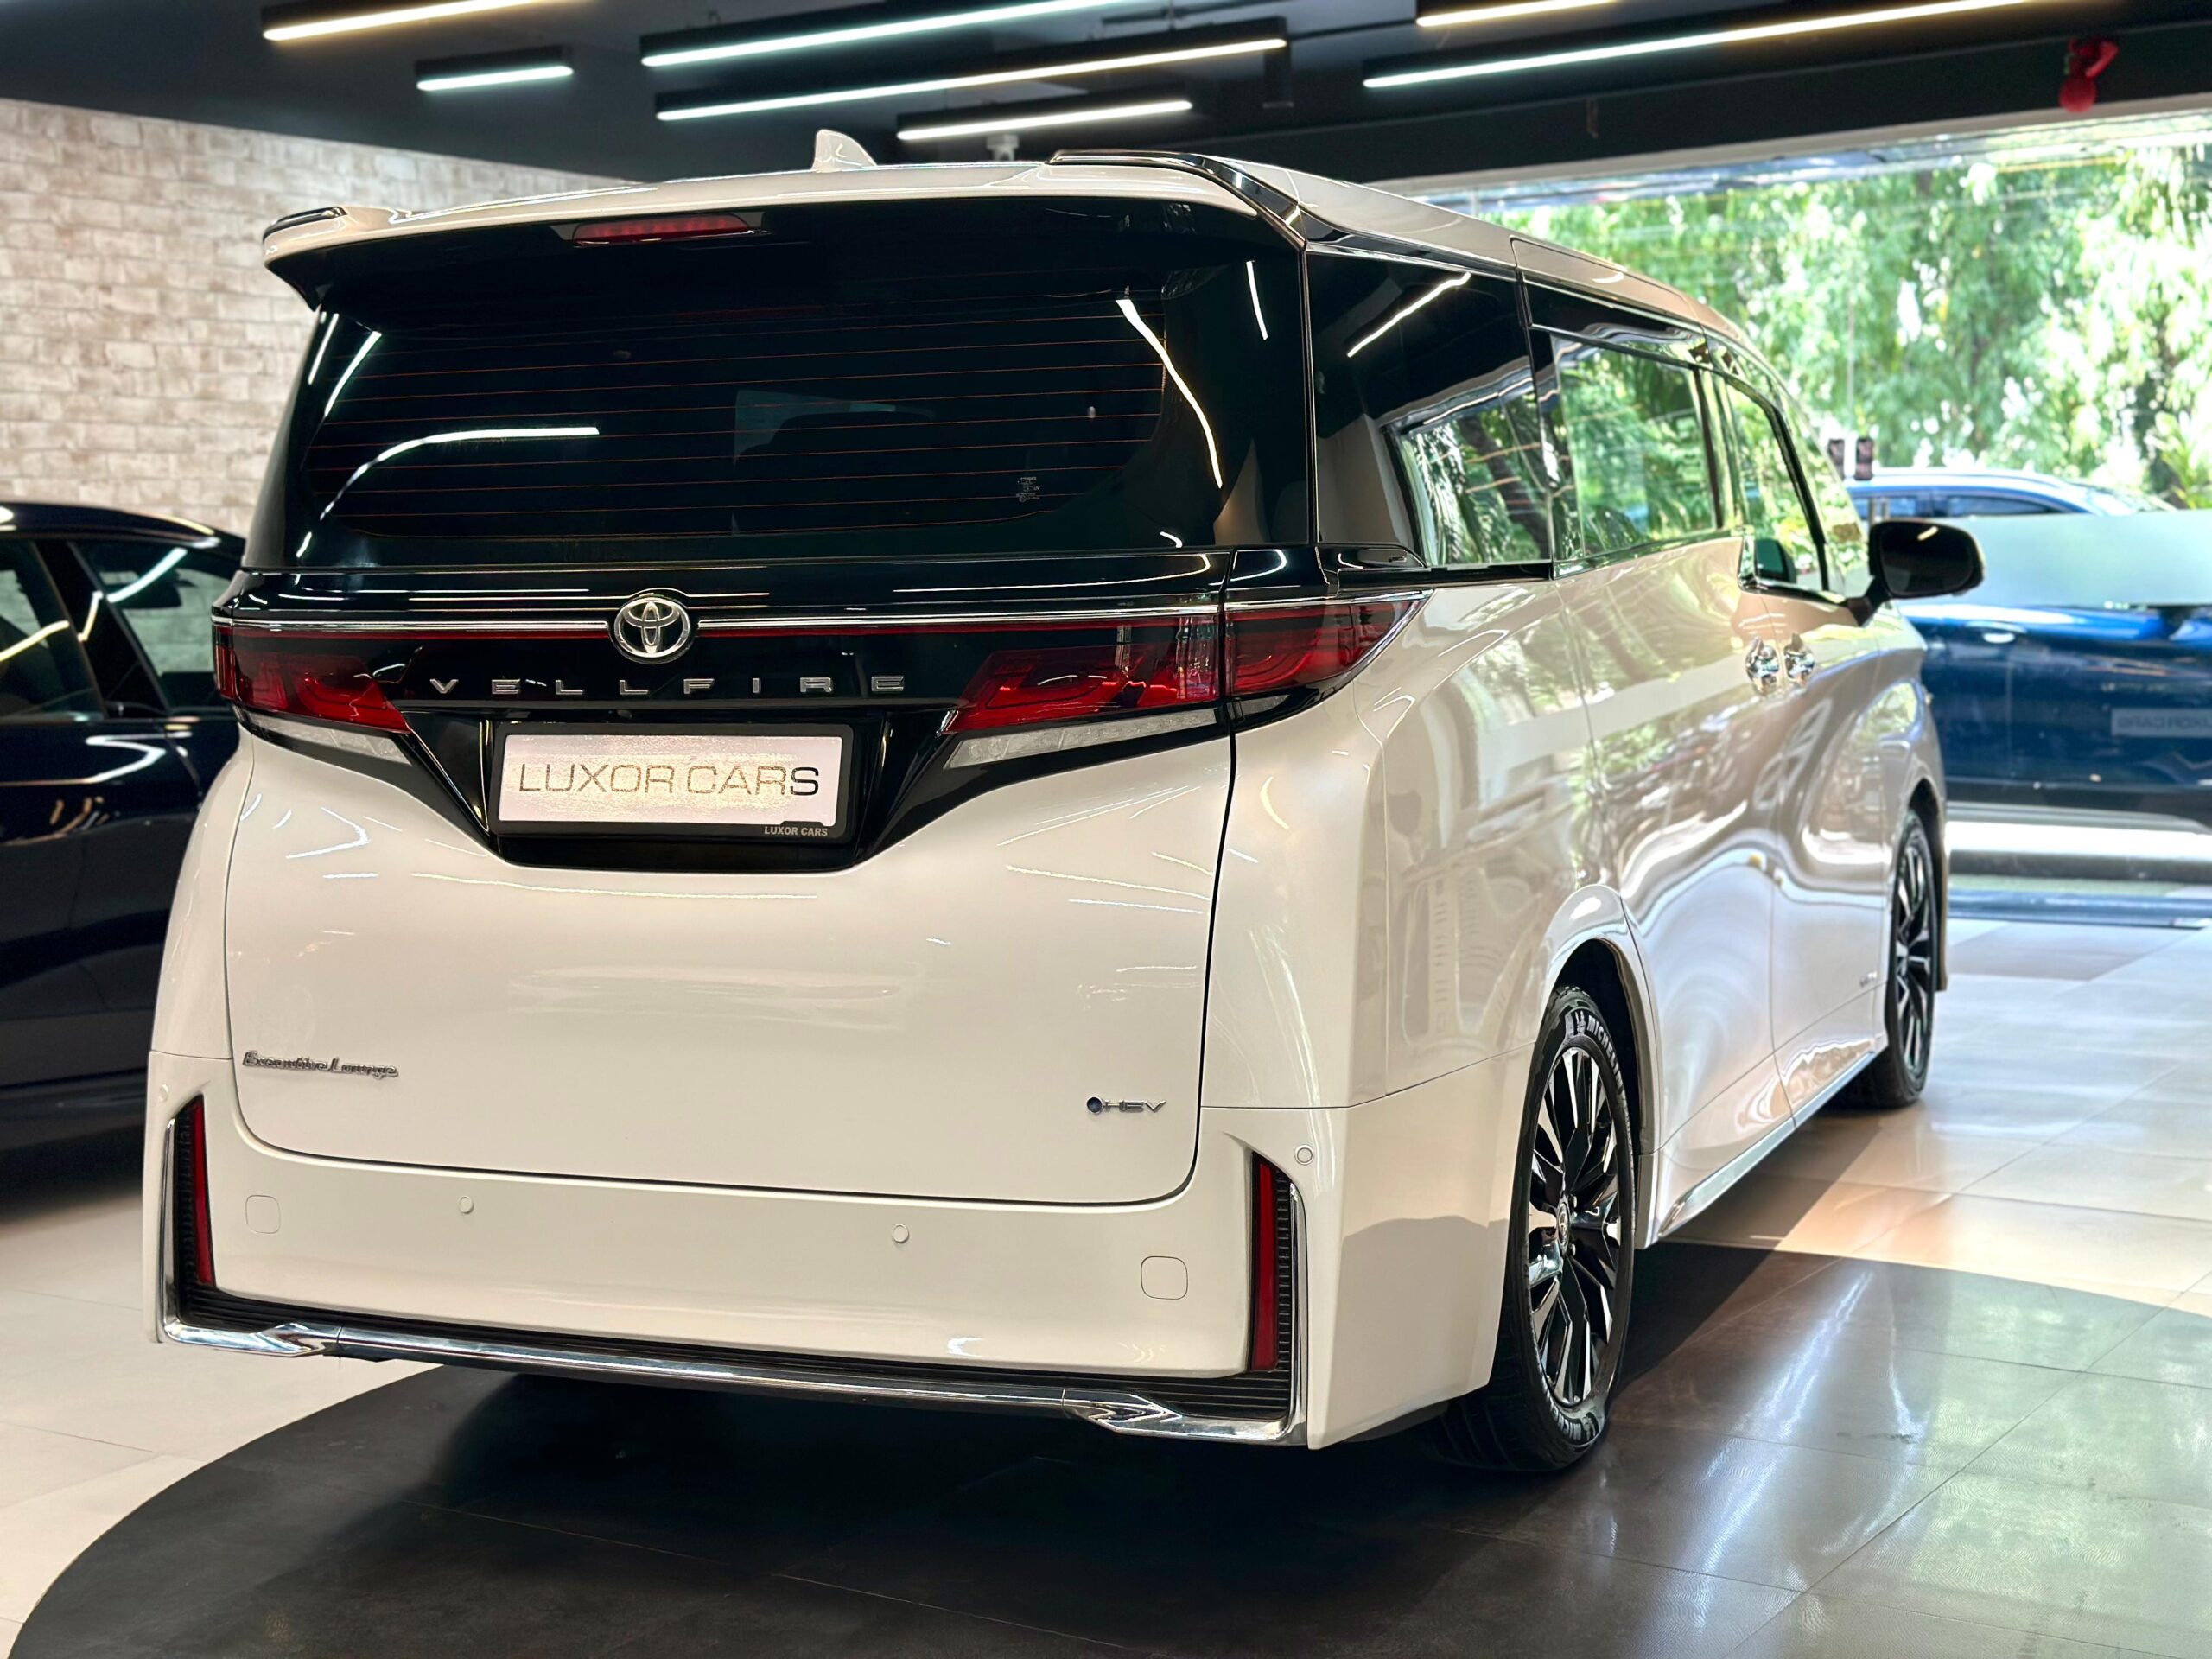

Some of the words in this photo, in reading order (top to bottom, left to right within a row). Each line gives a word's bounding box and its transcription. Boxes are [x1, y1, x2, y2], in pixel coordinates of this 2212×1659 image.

[429, 675, 905, 696] VELLFIRE
[518, 763, 676, 794] LUXOR
[687, 765, 820, 797] CARS
[764, 825, 798, 836] LUXOR
[800, 827, 828, 837] CARS
[242, 1050, 328, 1071] Executive
[1103, 1098, 1167, 1114] HEV
